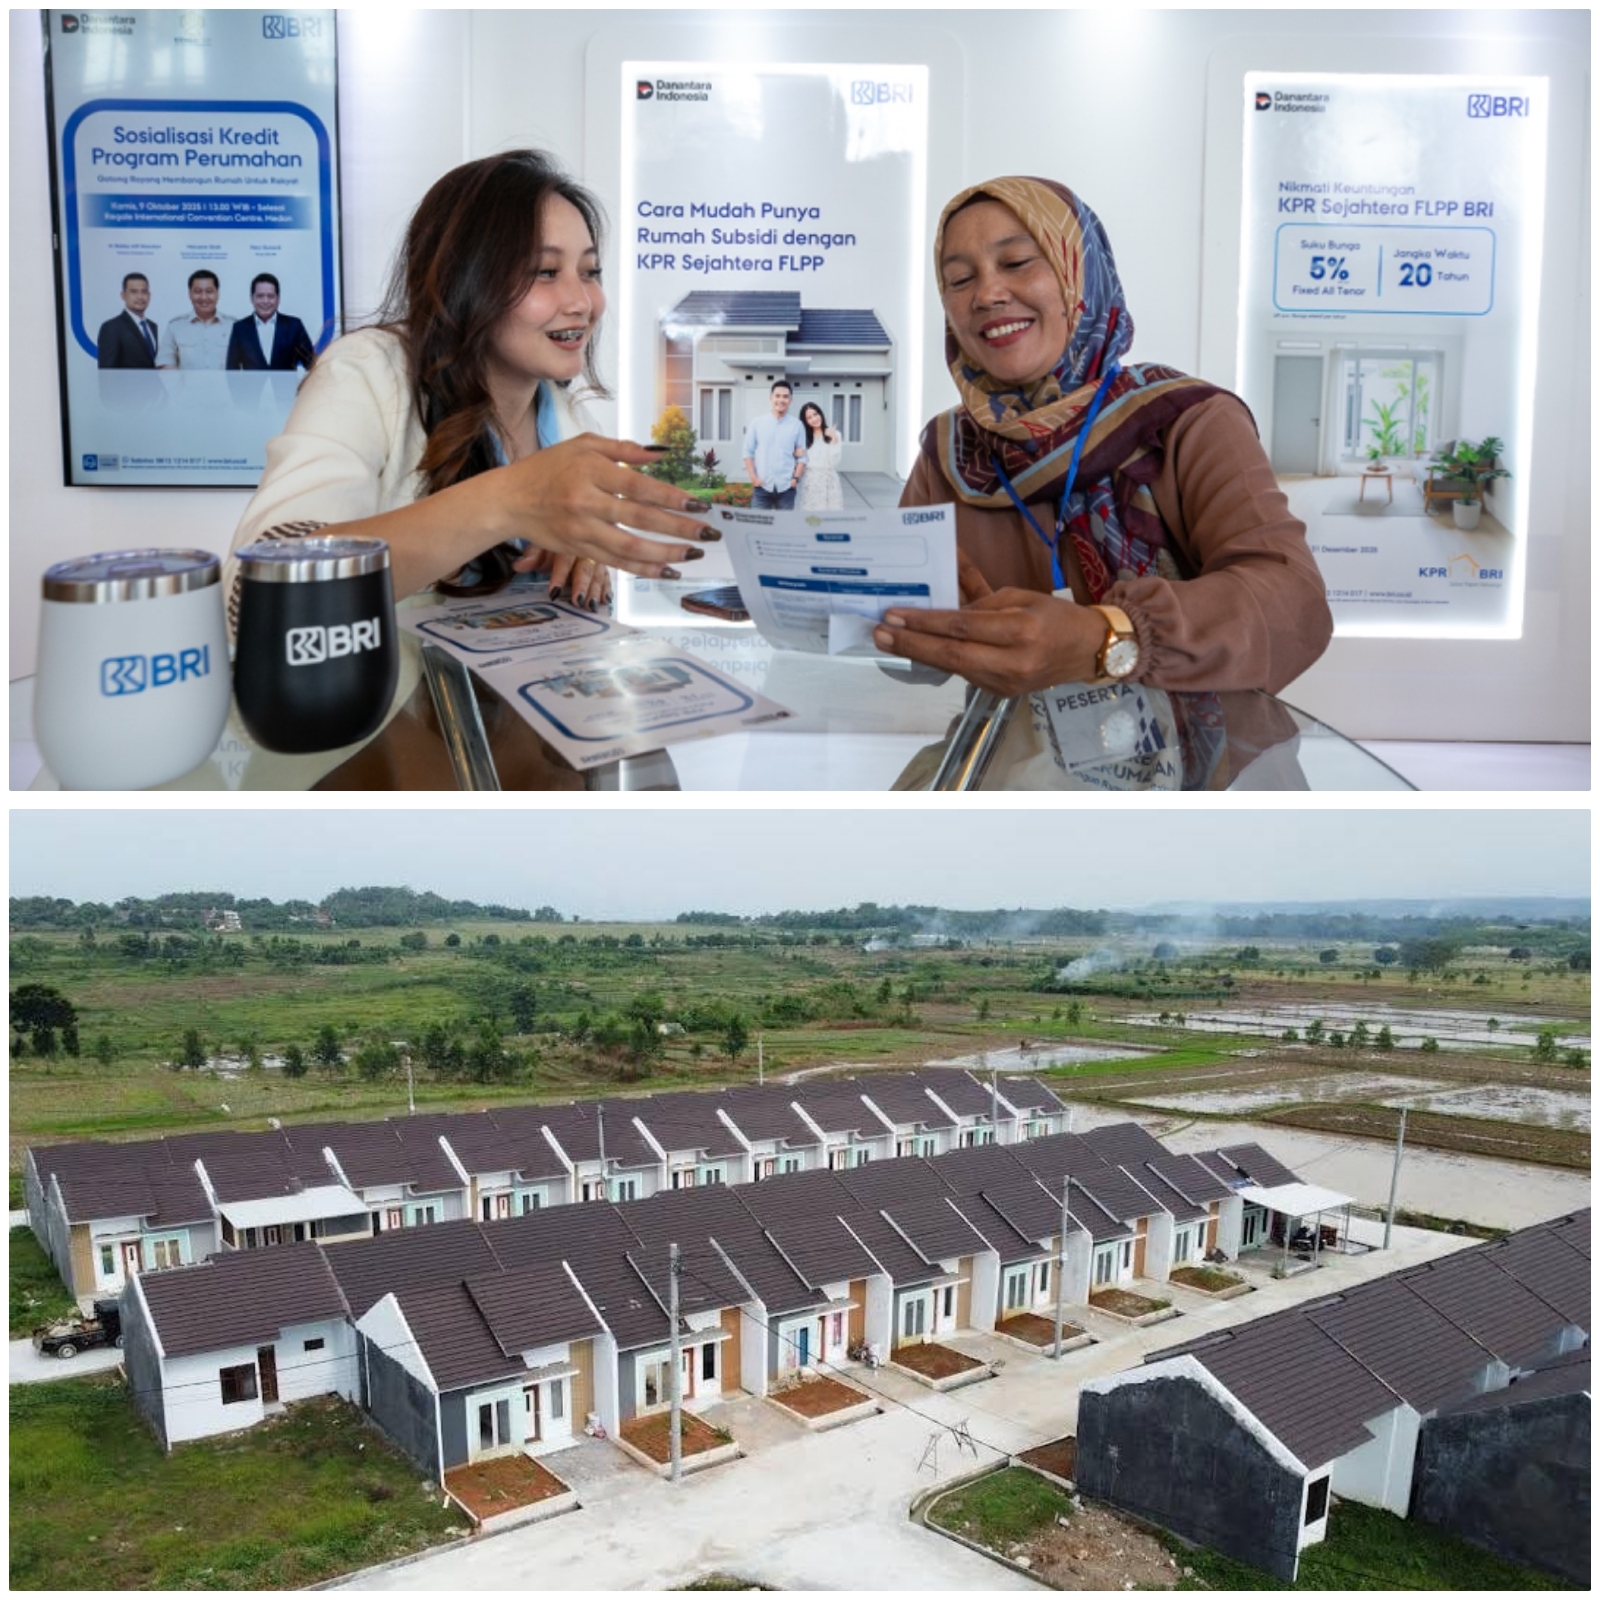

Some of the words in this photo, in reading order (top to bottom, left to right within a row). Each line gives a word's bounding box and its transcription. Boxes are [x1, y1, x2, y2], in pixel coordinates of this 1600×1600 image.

[80, 13, 136, 25] Danantara
[81, 25, 134, 36] Indonesia
[287, 17, 322, 38] BRI
[656, 80, 712, 91] Danantara
[876, 82, 913, 103] BRI
[656, 91, 709, 102] Indonesia
[1274, 91, 1330, 103] Danantara
[1274, 103, 1326, 113] Indonesia
[1492, 96, 1529, 117] BRI
[113, 126, 214, 145] Sosialisasi
[219, 127, 280, 146] Kredit
[91, 147, 180, 170] Program
[184, 149, 303, 168] Perumahan
[97, 175, 129, 185] Gotong
[162, 176, 214, 186] Membangun
[214, 176, 243, 185] Rumah
[244, 176, 268, 185] Untuk
[1278, 182, 1330, 193] Nikmati
[1333, 183, 1416, 198] Keuntungan
[146, 202, 179, 211] Oktober
[637, 201, 685, 218] Cara
[690, 201, 756, 219] Mudah
[761, 202, 820, 222] Punya
[1278, 198, 1316, 214] KPR
[1321, 198, 1409, 218] Sejahtera
[1414, 200, 1459, 217] FLPP
[1464, 201, 1494, 217] BRI
[134, 212, 185, 222] International
[187, 213, 234, 223] Convention
[637, 227, 705, 244] Rumah
[711, 227, 778, 245] Subsidi
[782, 229, 857, 250] dengan
[1300, 239, 1326, 250] Suku
[1328, 240, 1361, 252] Bunga
[1393, 249, 1432, 260] Jangka
[1434, 249, 1470, 260] Waktu
[637, 253, 676, 270] KPR
[681, 253, 773, 274] Sejahtera
[778, 255, 825, 272] FLPP
[1309, 255, 1350, 281] 5%
[1398, 262, 1433, 288] 20
[1437, 271, 1470, 282] Tahun
[1292, 284, 1320, 296] Fixed
[1321, 285, 1335, 296] All
[1337, 286, 1366, 297] Tenor
[919, 510, 945, 524] BRI
[1322, 545, 1358, 554] Desember
[1418, 566, 1448, 578] KPR
[1478, 568, 1504, 580] BRI
[328, 616, 381, 659] BRI
[151, 644, 210, 688] BRI
[1055, 684, 1135, 713] PESERTA
